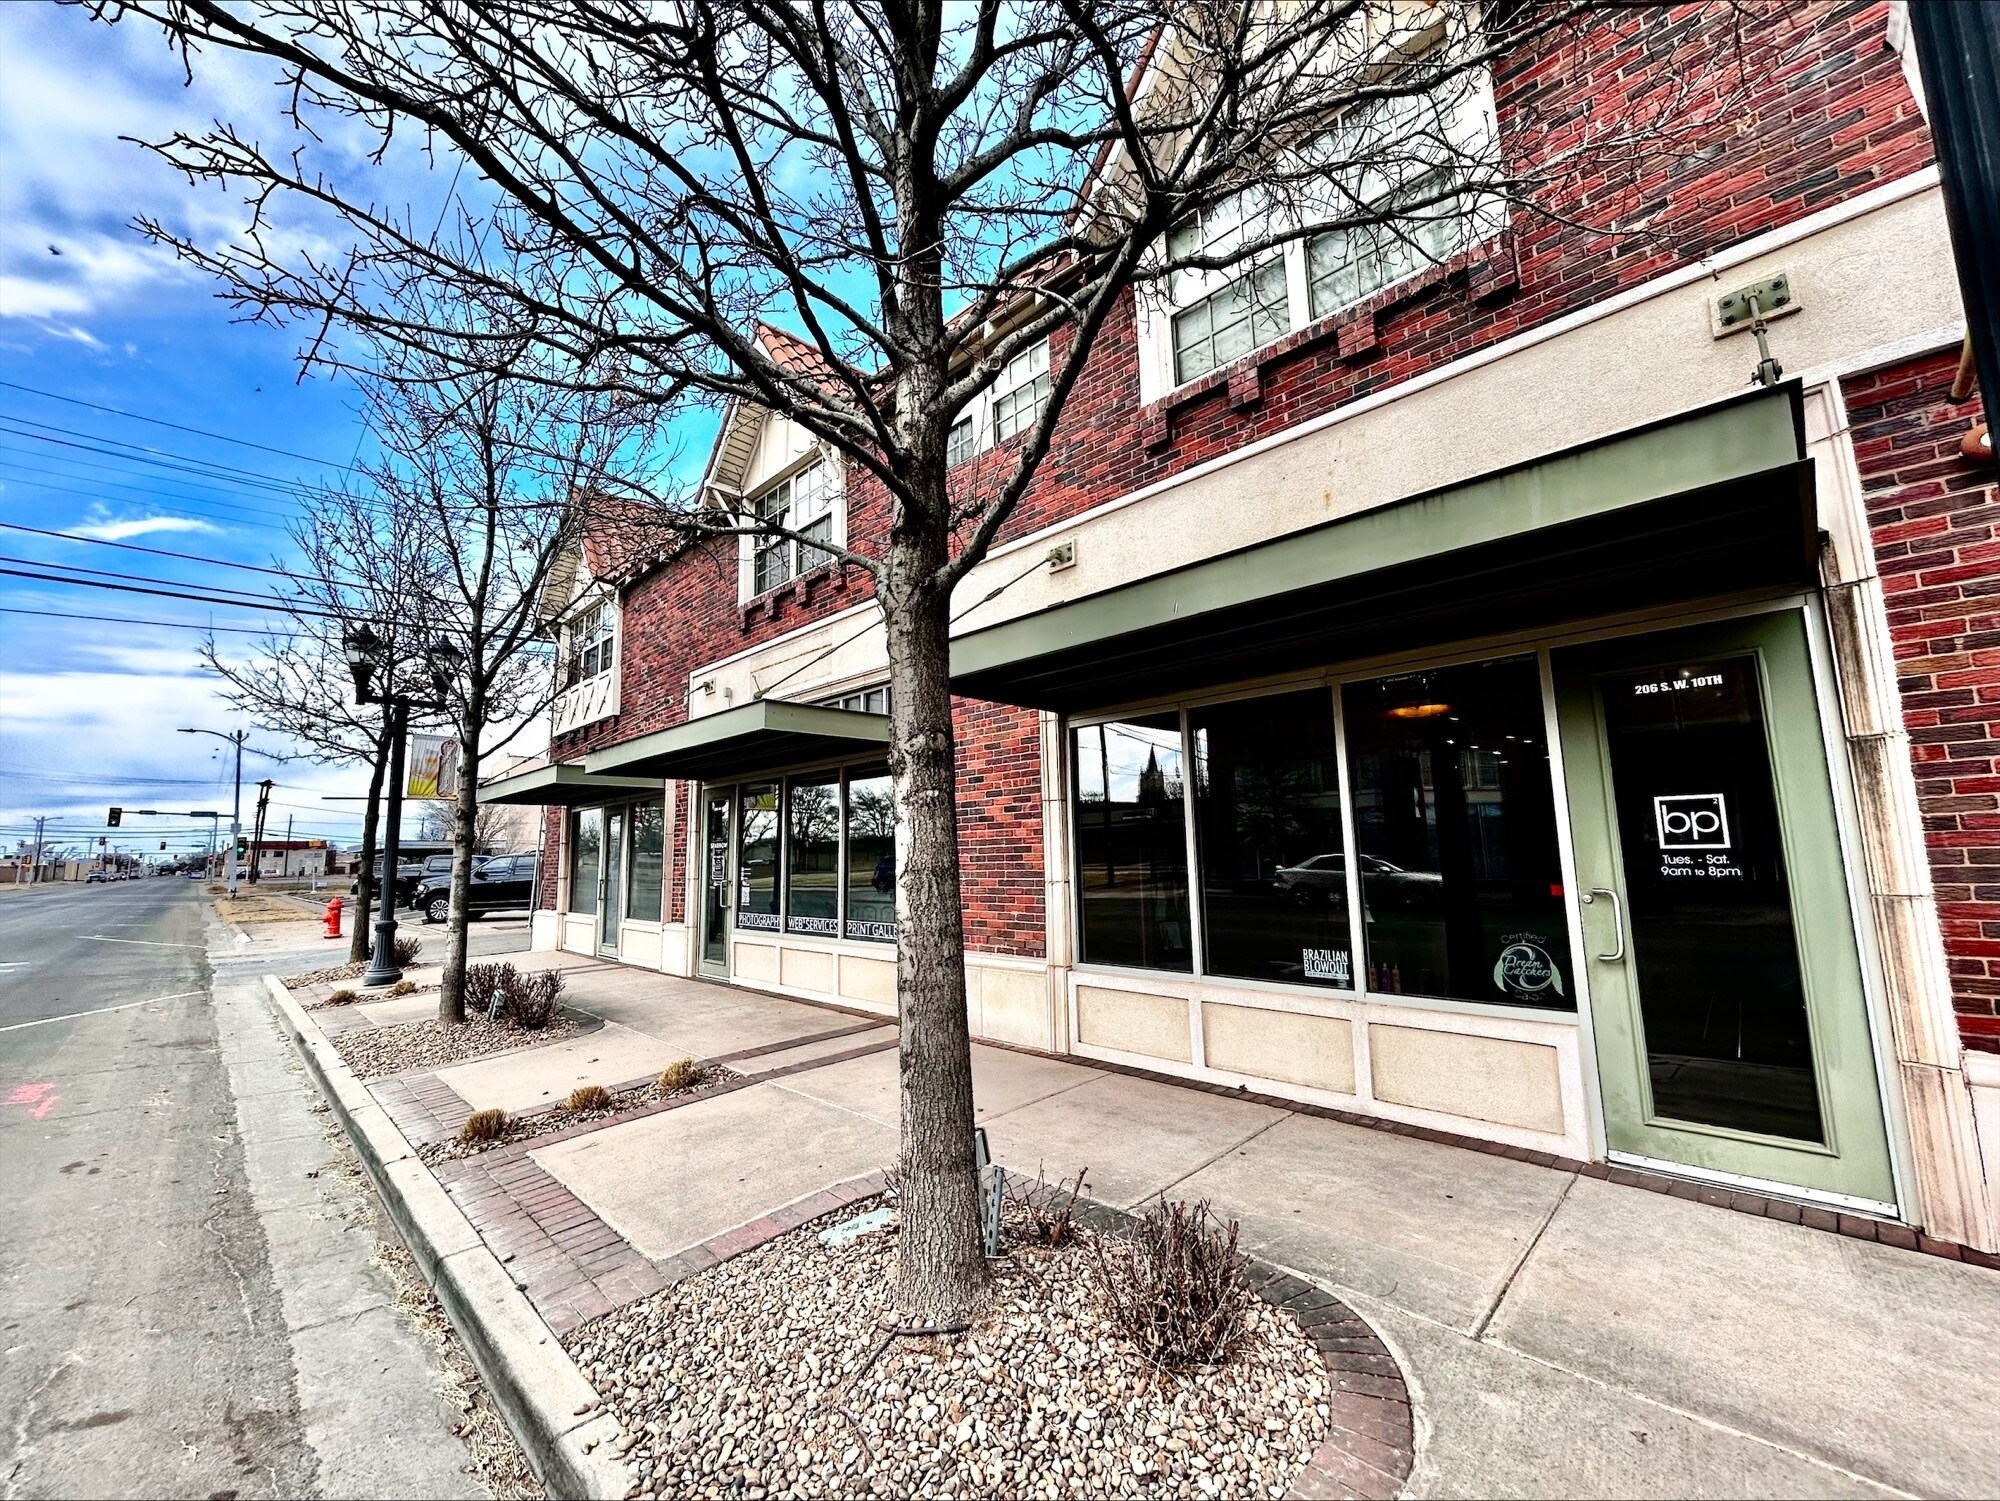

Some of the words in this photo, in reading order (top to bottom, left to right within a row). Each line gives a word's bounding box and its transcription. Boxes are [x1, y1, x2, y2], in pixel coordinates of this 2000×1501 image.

[1635, 683, 1658, 694] 206
[1660, 681, 1672, 691] S.
[1673, 679, 1689, 689] W.
[1691, 675, 1722, 687] 10TH
[1662, 805, 1720, 840] bp
[1662, 855, 1693, 864] Tues.
[1706, 854, 1730, 864] Sat.
[1661, 867, 1691, 876] 9am
[1708, 867, 1741, 878] 8pm
[805, 920, 838, 932] SERVICES
[848, 922, 871, 936] PRINT
[872, 925, 897, 938] GALLE
[1501, 932, 1547, 944] Certified
[1303, 949, 1348, 962] BRAZILIAN
[1504, 955, 1542, 968] Dream
[1304, 960, 1349, 974] BLOWOUT
[1504, 965, 1551, 977] Catchers
